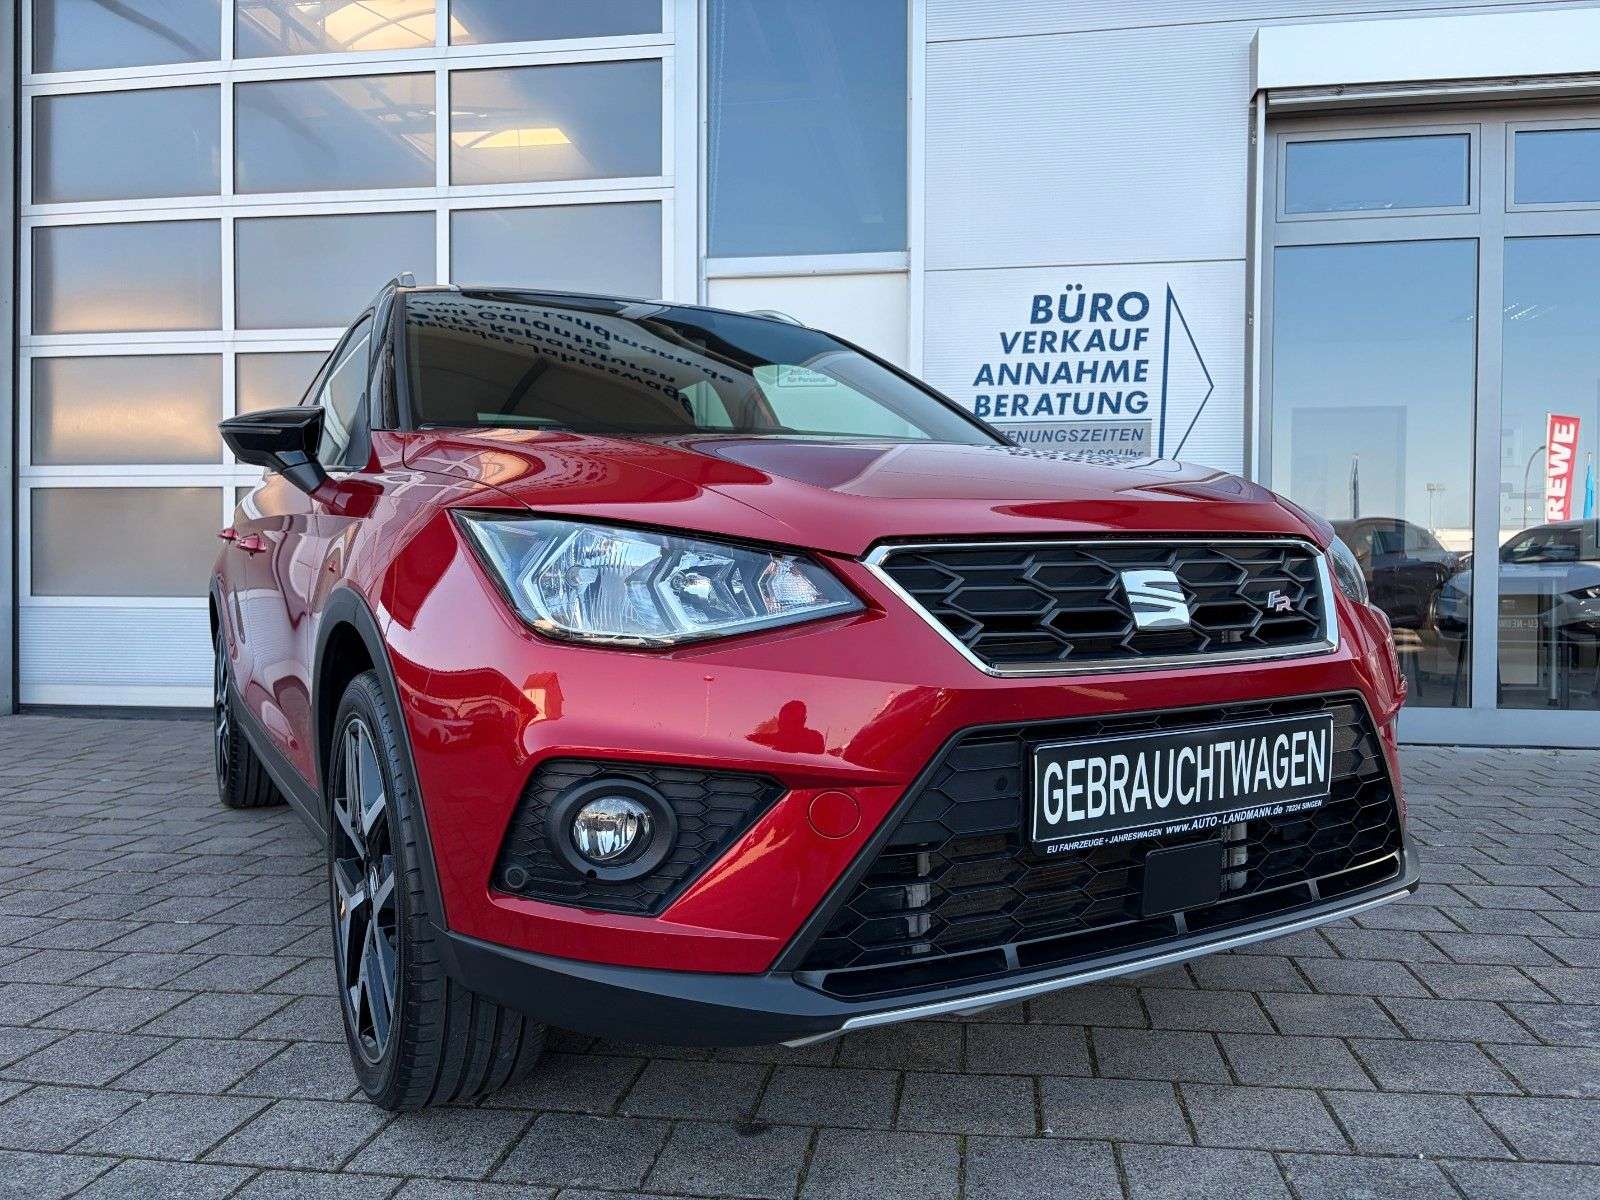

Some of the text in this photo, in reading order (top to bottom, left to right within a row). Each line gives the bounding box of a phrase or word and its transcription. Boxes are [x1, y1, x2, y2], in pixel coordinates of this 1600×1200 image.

[1030, 283, 1150, 325] BÜRO
[1000, 327, 1150, 354] VERKAUF
[972, 359, 1149, 387] ANNAHME
[974, 390, 1149, 418] BERATUNG
[1001, 428, 1144, 444] FNUNGSZEITEN
[1547, 422, 1576, 521] REWE
[1267, 589, 1295, 612] FR
[1043, 728, 1326, 825] GEBRAUCHTWAGEN
[1046, 844, 1059, 854] EU
[1059, 837, 1105, 851] FAHRZEUGE
[1109, 828, 1163, 844] JAHRESWAGEN
[1302, 799, 1323, 810] SINGEN
